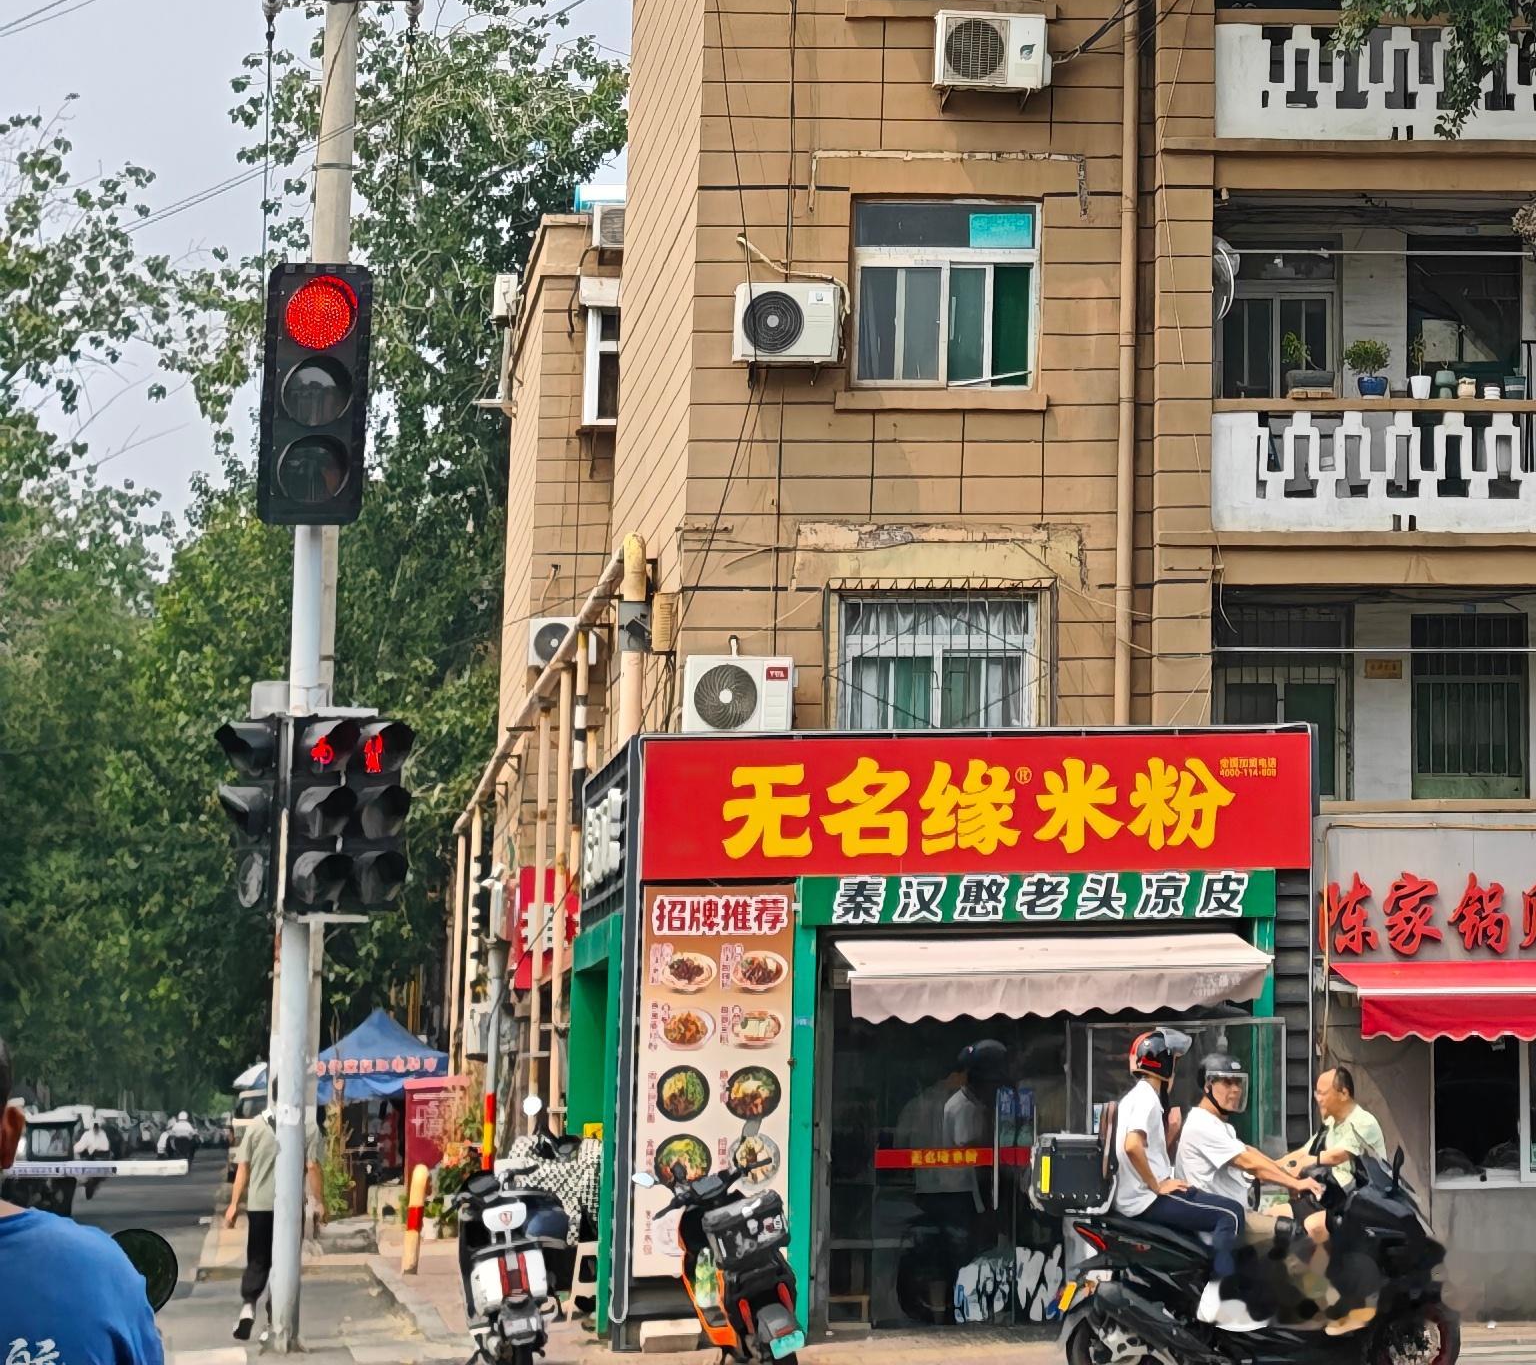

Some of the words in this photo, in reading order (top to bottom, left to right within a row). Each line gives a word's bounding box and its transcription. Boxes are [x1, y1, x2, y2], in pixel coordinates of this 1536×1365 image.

[722, 756, 1236, 858] 无名缘米粉
[653, 895, 788, 936] 招牌推荐
[833, 871, 1250, 923] 秦汉憨老头凉皮
